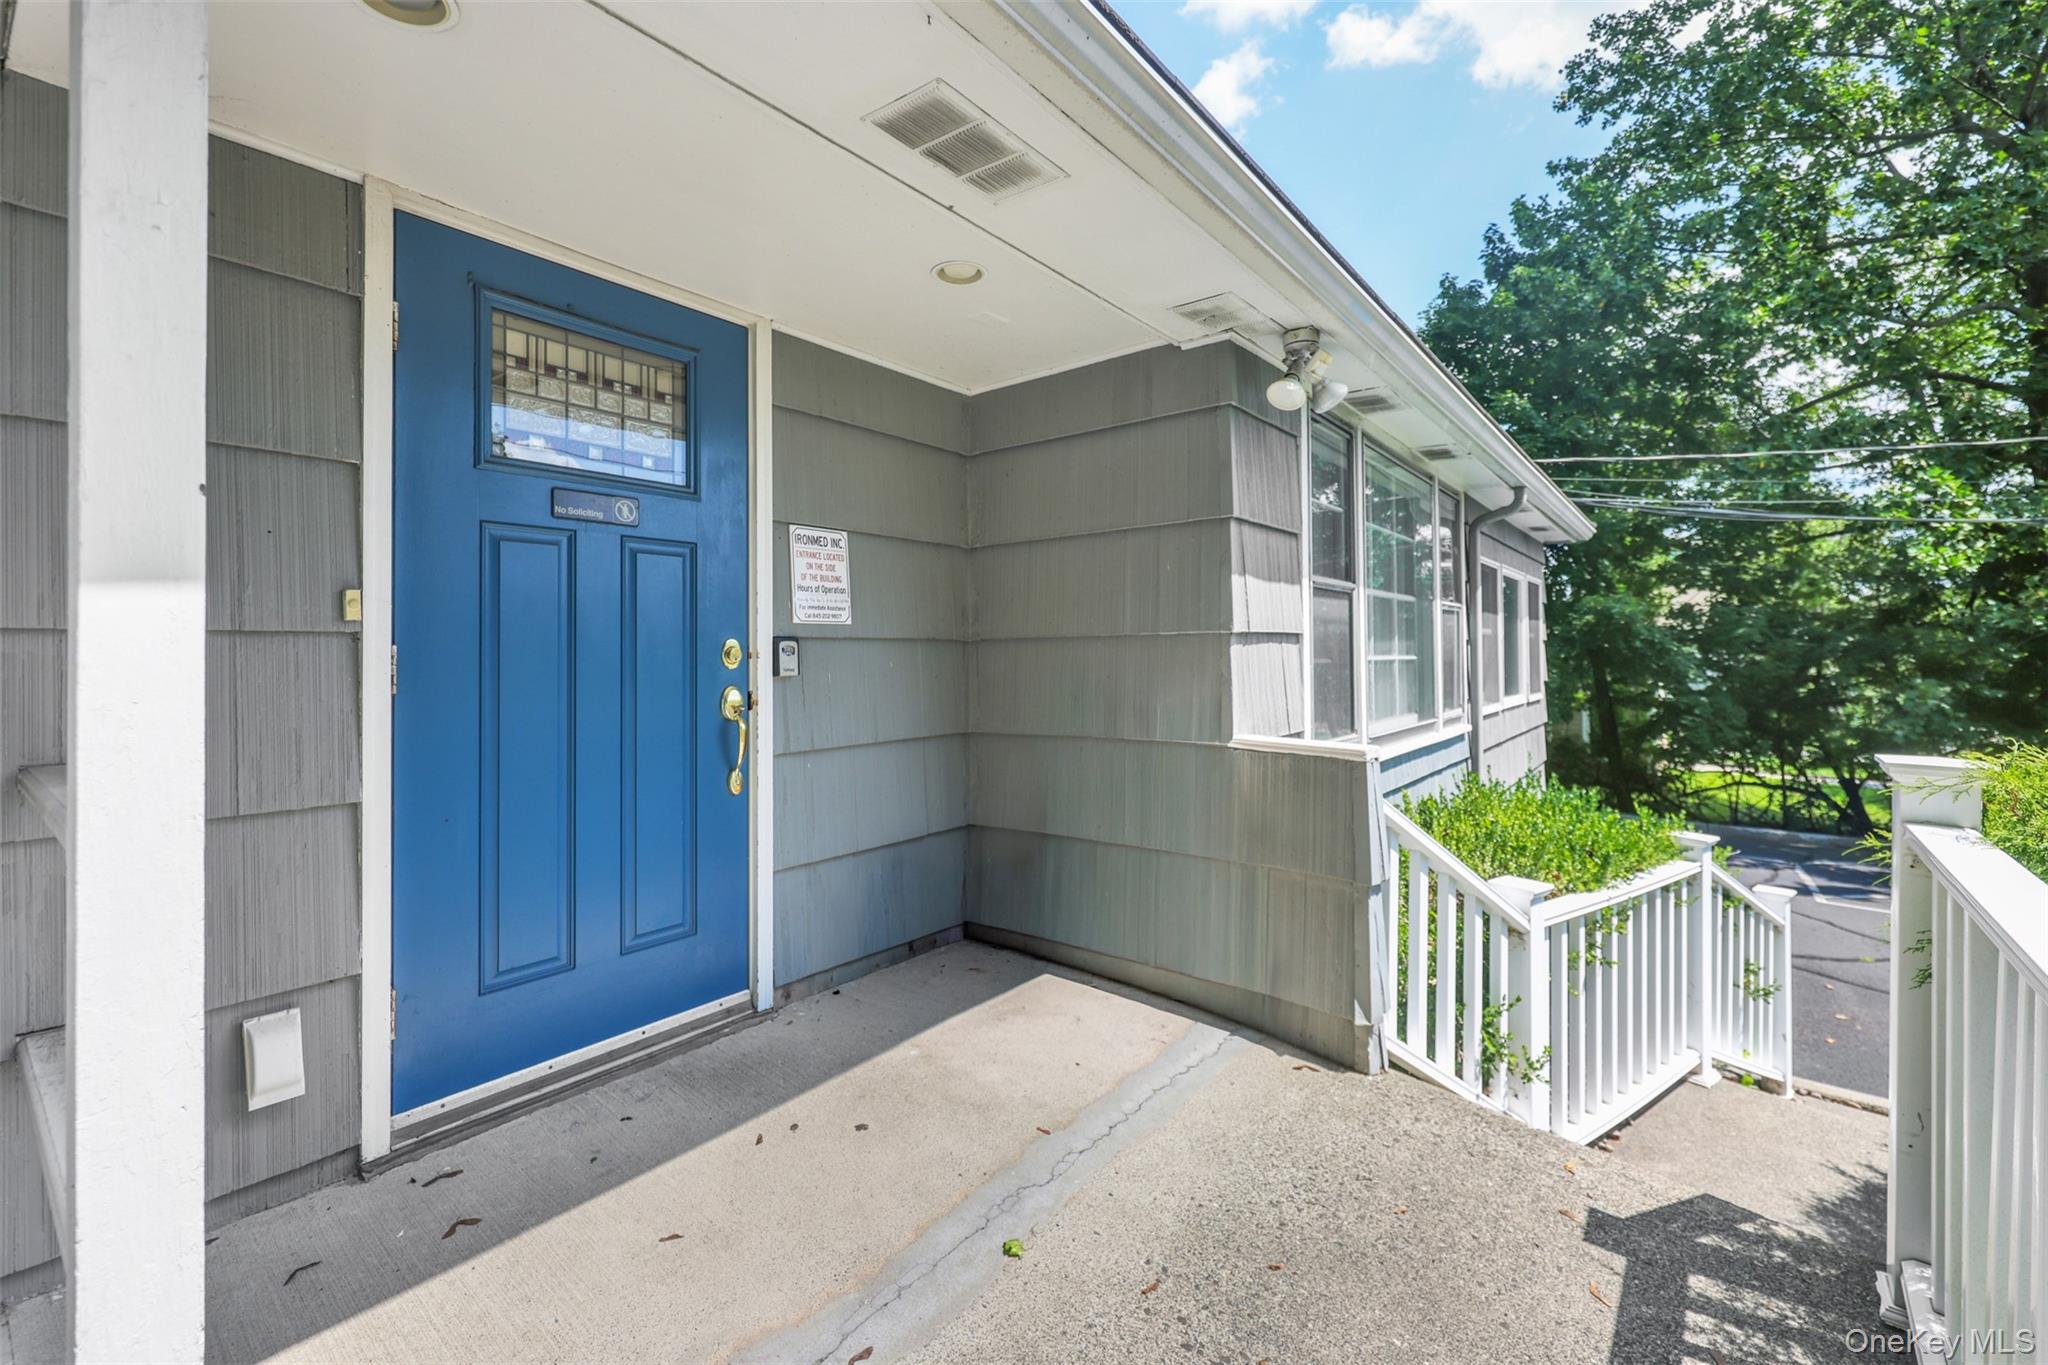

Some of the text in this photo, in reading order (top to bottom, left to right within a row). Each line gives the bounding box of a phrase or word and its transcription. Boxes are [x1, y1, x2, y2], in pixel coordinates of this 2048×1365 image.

[554, 505, 604, 519] No Soliciting
[794, 533, 829, 548] IRONMED
[795, 549, 845, 562] ENTRANCE LOCATED
[806, 562, 837, 572] ON THE SIDE
[808, 573, 819, 582] THE
[819, 574, 843, 583] BUILDING
[797, 583, 847, 596] Hours of Operation
